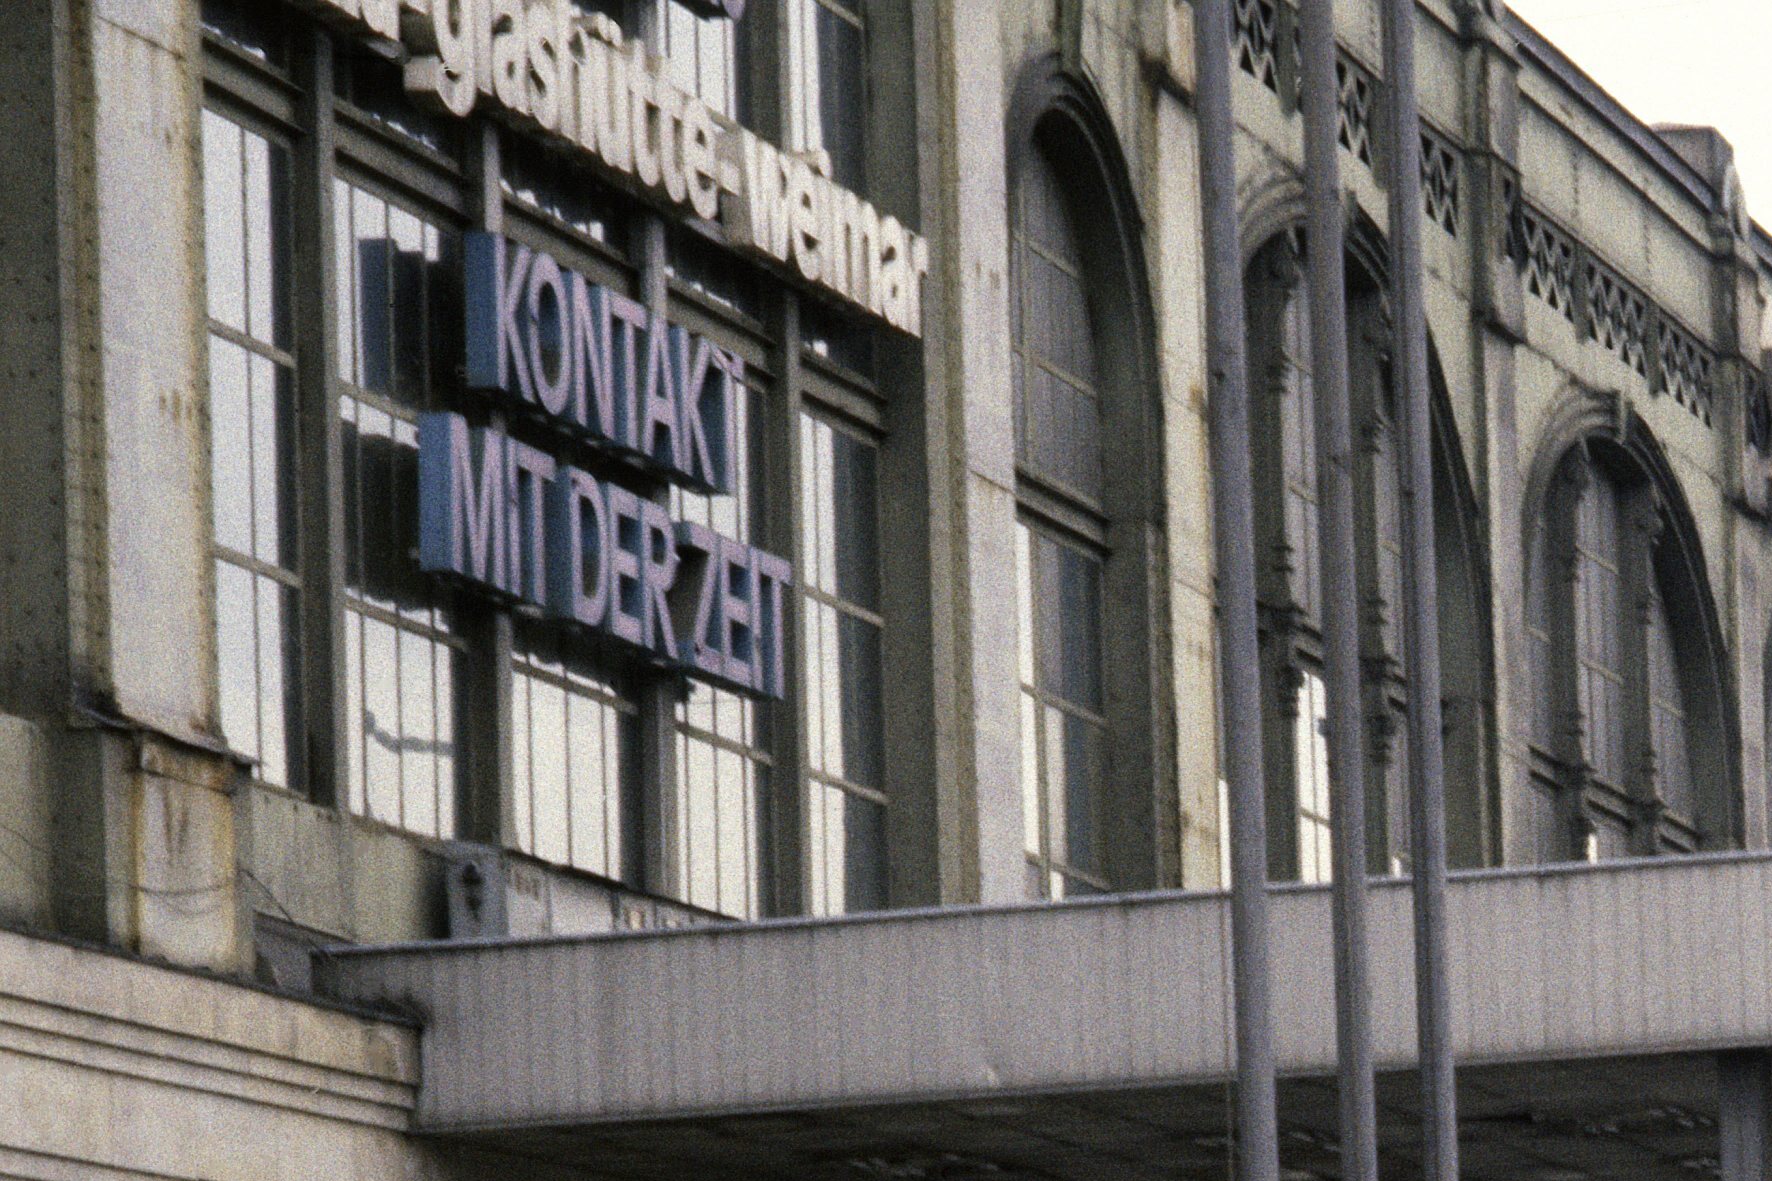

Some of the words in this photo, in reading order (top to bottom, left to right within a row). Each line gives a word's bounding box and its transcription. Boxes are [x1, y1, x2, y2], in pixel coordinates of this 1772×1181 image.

[325, 0, 929, 337] glashütte-weimar
[492, 232, 744, 496] KONTAKT
[446, 412, 557, 606] MIT
[567, 466, 681, 660] DER
[691, 521, 794, 700] ZEIT
